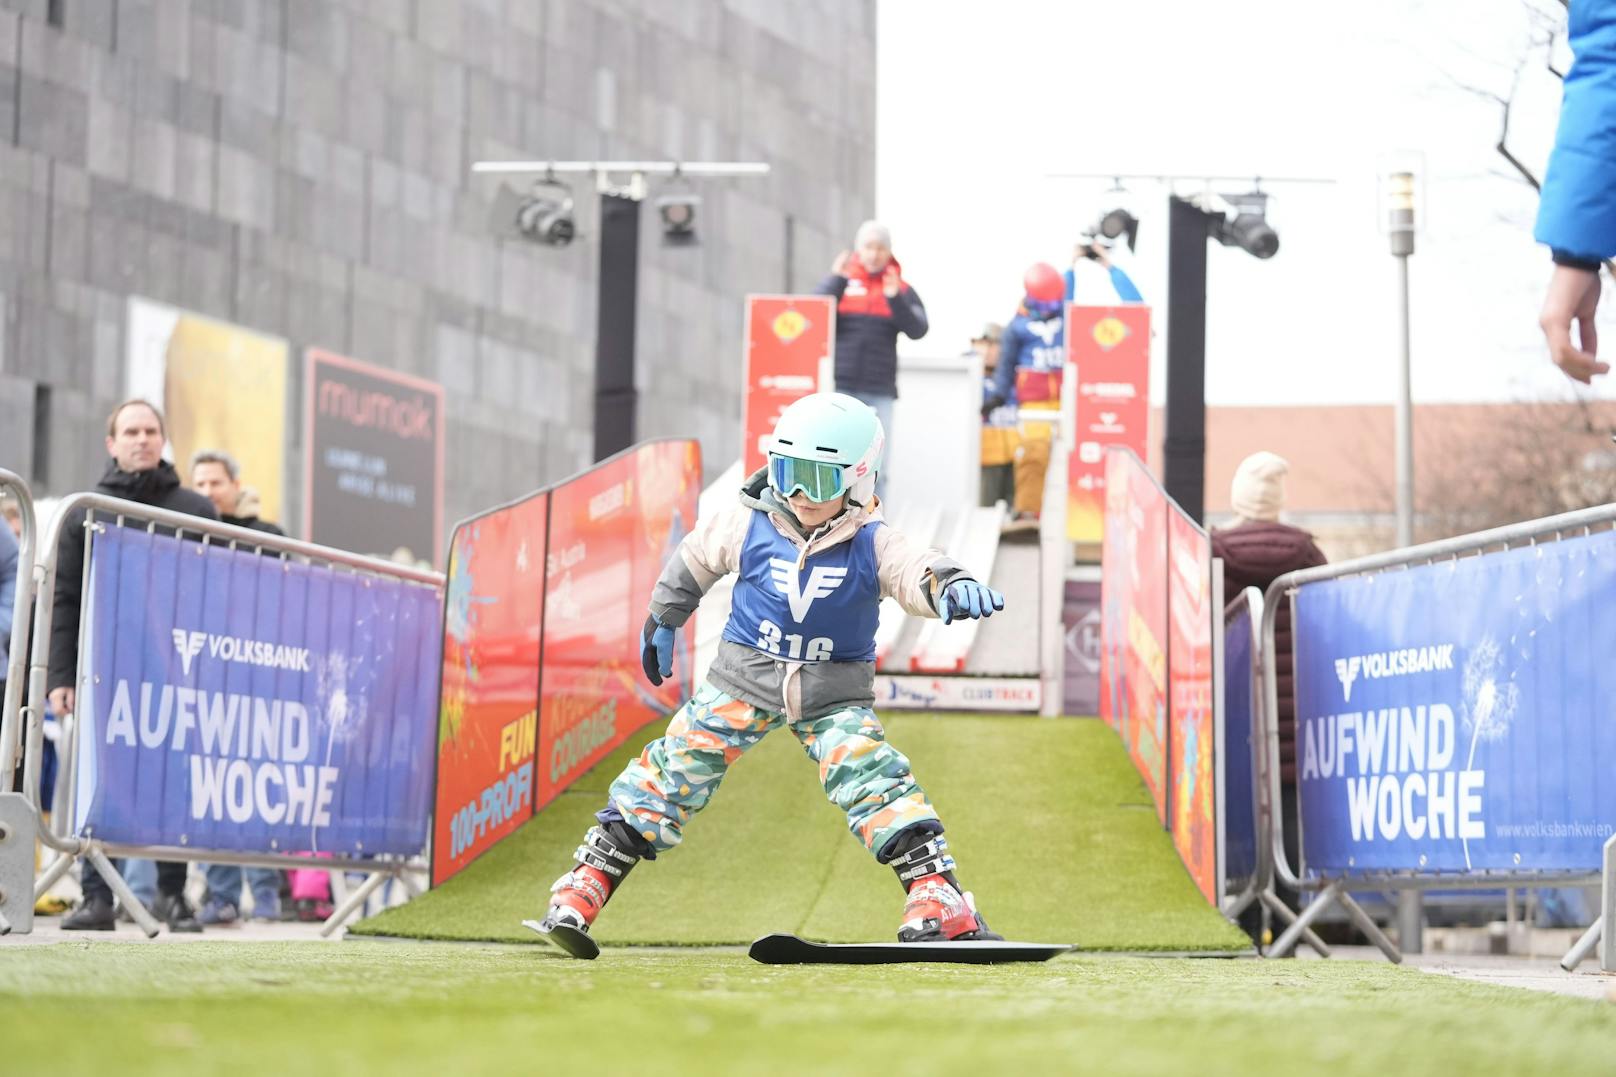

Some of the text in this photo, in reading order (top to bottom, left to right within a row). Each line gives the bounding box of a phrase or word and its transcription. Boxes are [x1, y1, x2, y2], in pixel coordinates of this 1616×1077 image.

[208, 634, 309, 672] VOLKSBANK
[757, 619, 834, 661] 316
[1362, 644, 1454, 679] VOLKSBANK
[106, 679, 310, 763] AUFWIND
[499, 709, 538, 773] FUN
[1303, 703, 1456, 781] AUFWIND
[190, 753, 340, 828] WOCHE
[450, 760, 533, 860] 100-PROFI
[1347, 769, 1486, 842] WOCHE
